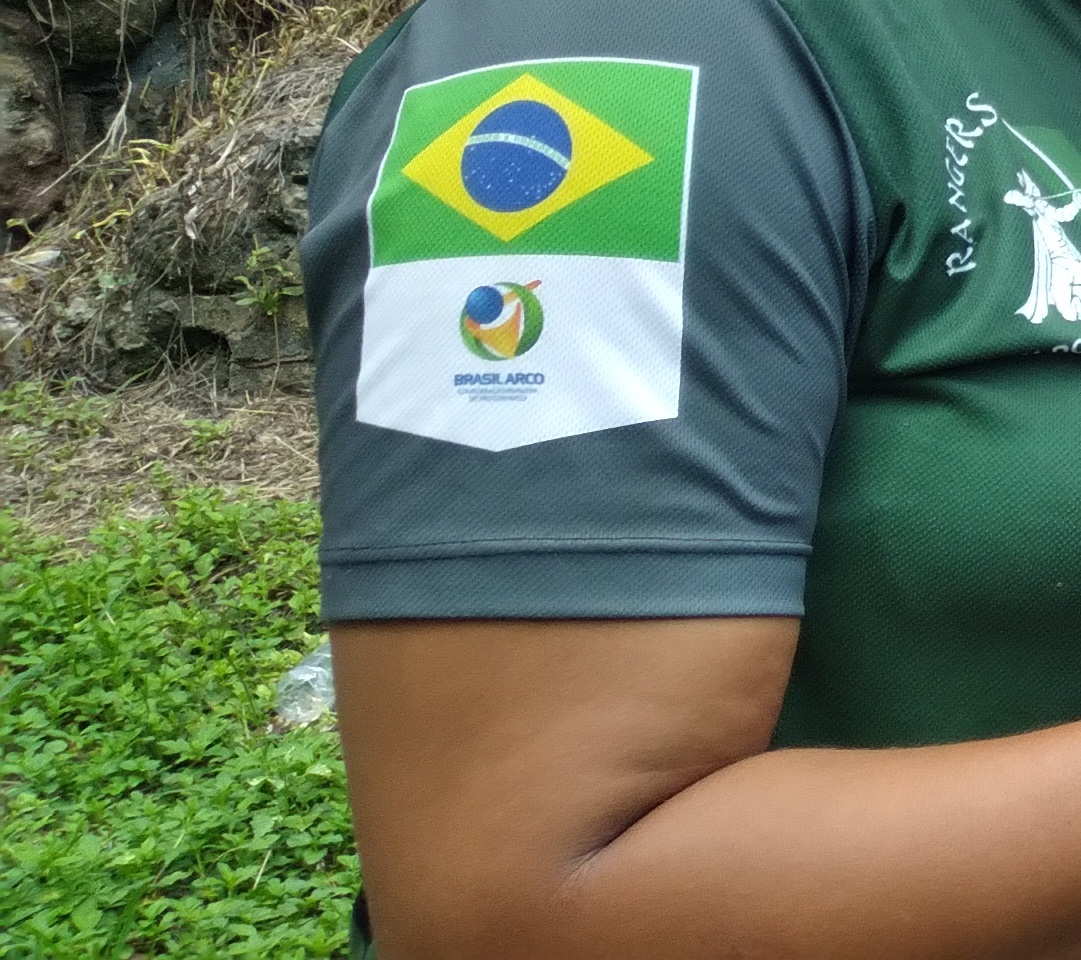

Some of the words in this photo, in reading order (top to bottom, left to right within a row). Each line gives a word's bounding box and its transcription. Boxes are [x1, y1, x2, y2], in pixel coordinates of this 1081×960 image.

[945, 92, 998, 276] RANGERS
[454, 372, 503, 386] BRASIL
[504, 372, 545, 385] ARCO
